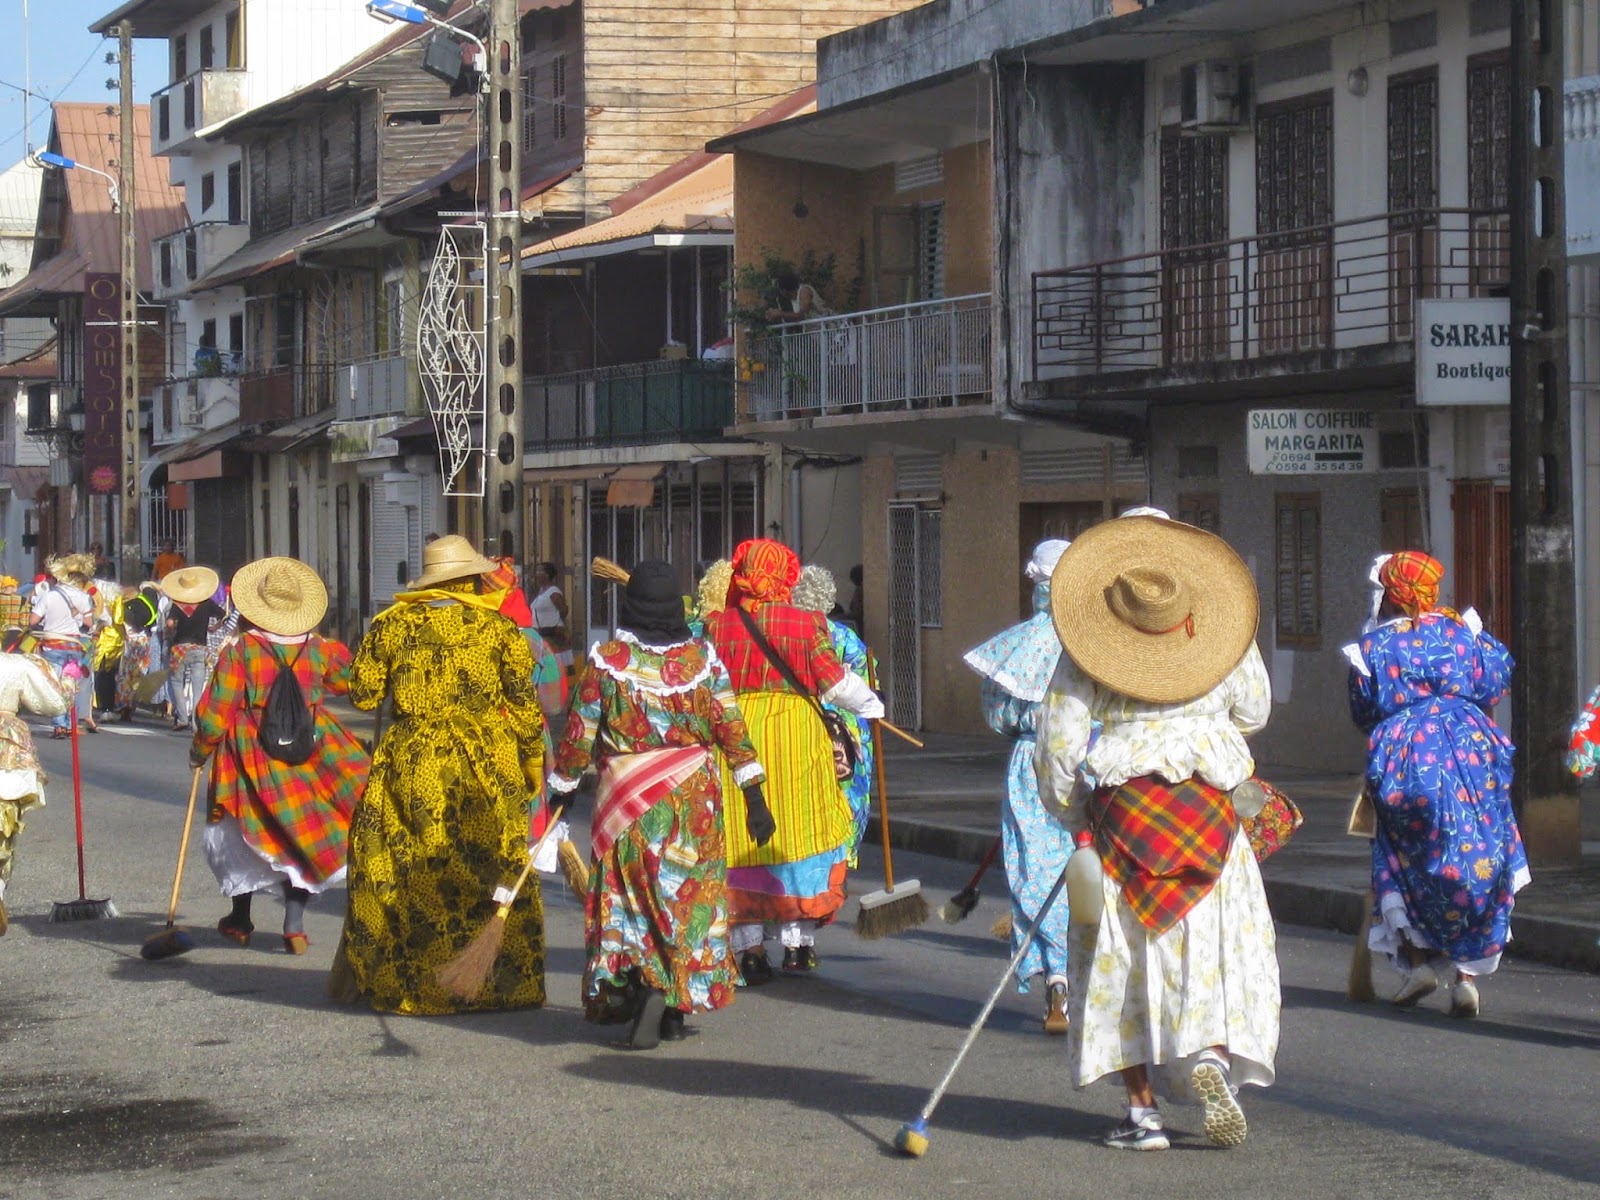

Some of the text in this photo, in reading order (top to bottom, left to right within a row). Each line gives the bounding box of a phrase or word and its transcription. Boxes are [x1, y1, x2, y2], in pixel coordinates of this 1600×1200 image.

[1431, 324, 1510, 347] SARAH
[1437, 362, 1511, 381] Boutique
[1252, 411, 1374, 429] SALON COIFFURE
[1265, 434, 1364, 450] MARGARITA
[1280, 453, 1312, 462] 0694
[1275, 462, 1307, 471] 0594
